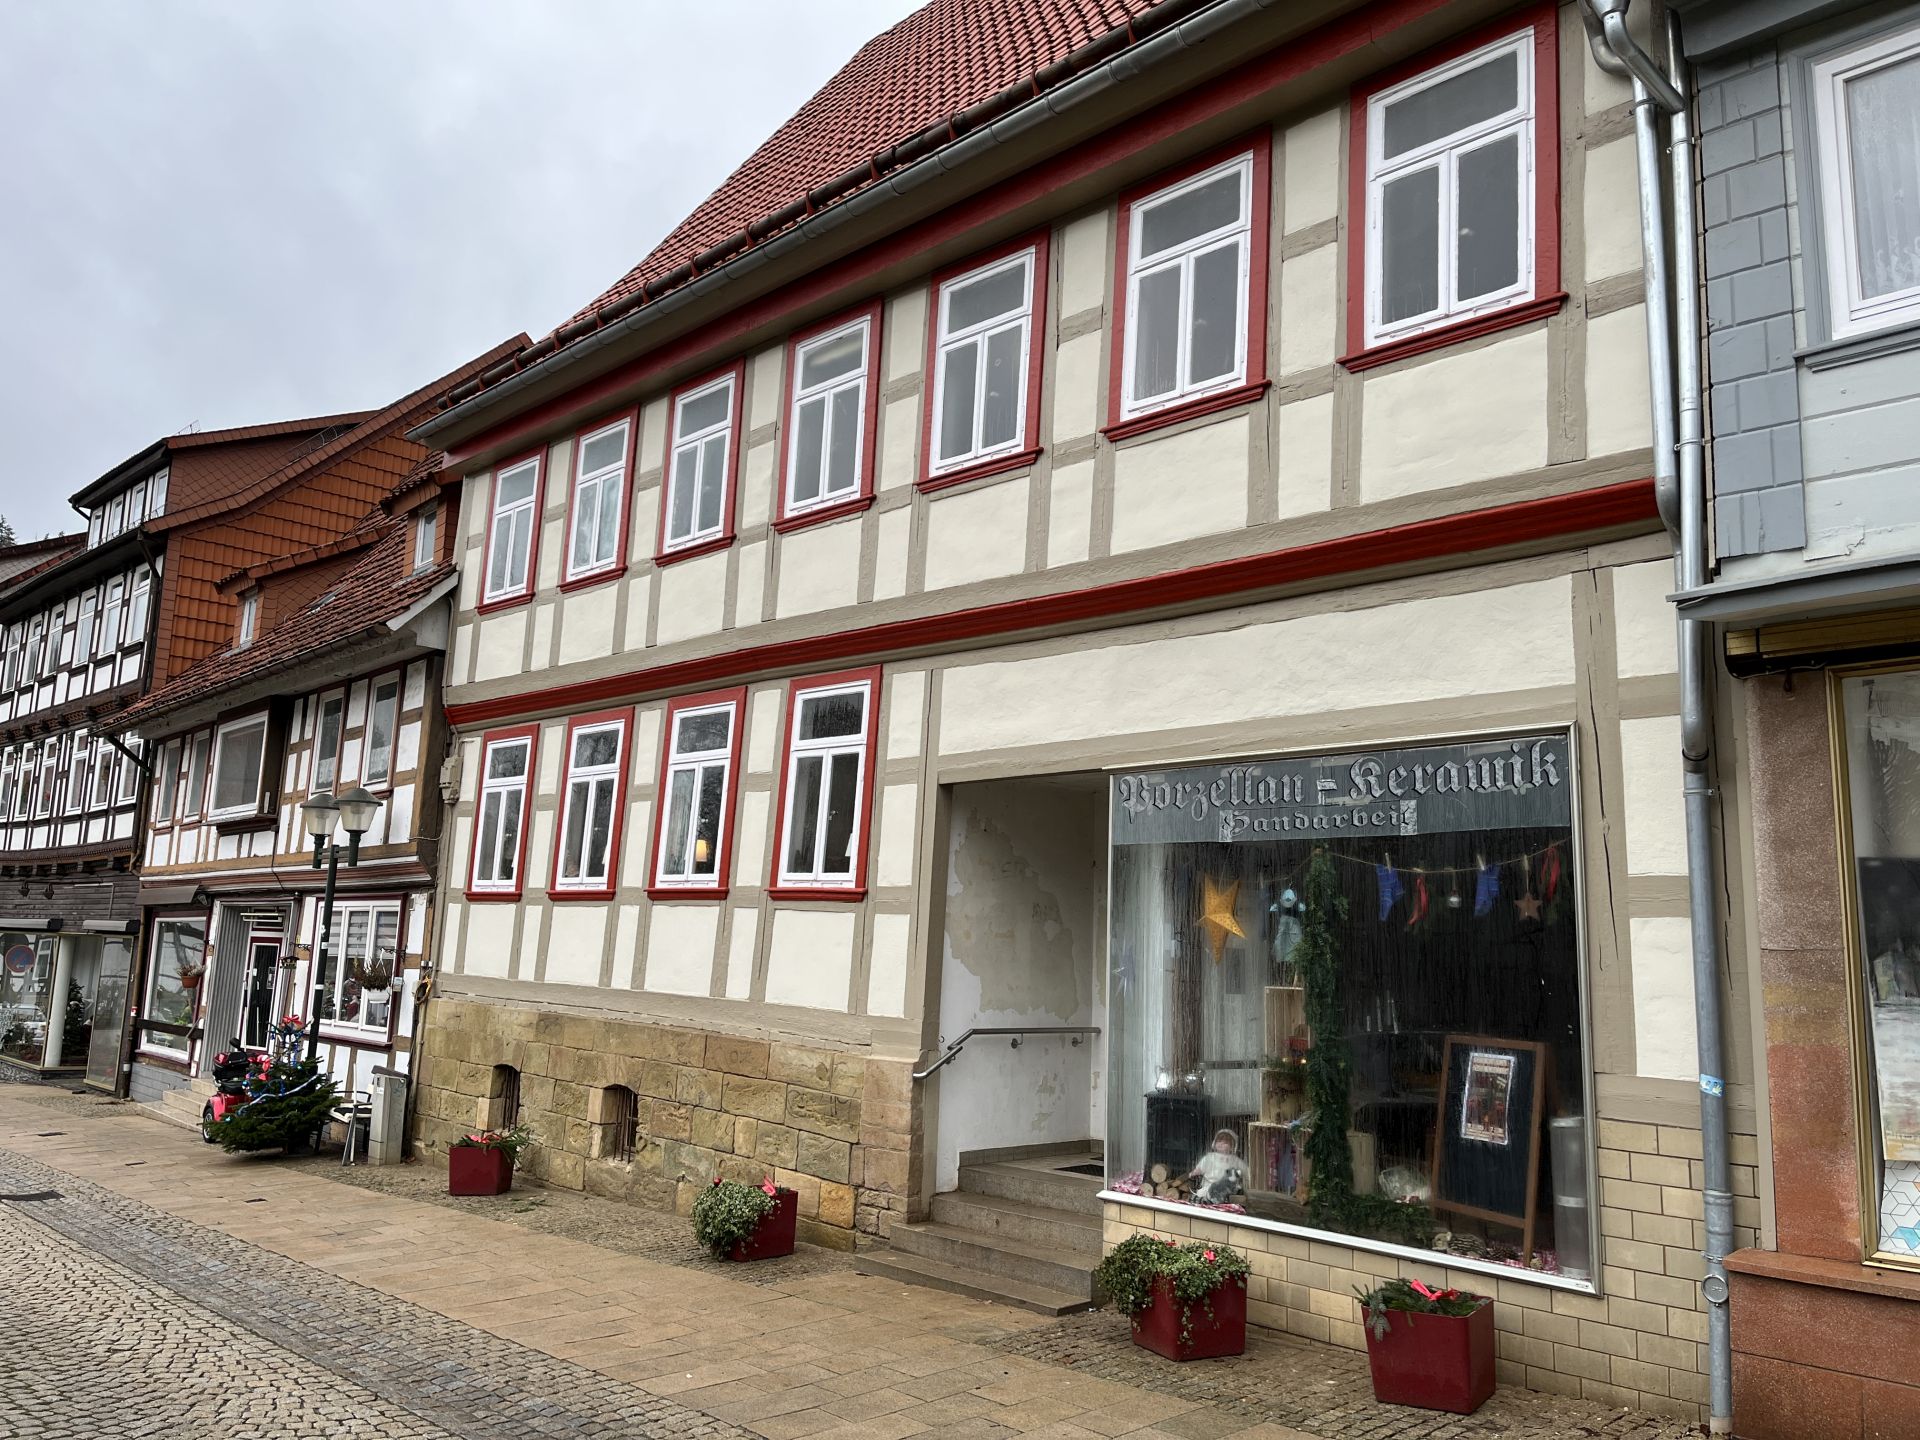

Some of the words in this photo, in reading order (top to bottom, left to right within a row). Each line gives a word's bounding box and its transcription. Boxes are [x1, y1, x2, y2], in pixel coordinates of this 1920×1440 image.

[1119, 767, 1304, 823] Porzellan
[1349, 741, 1560, 799] Keramik
[1222, 802, 1411, 837] Handarbeit
